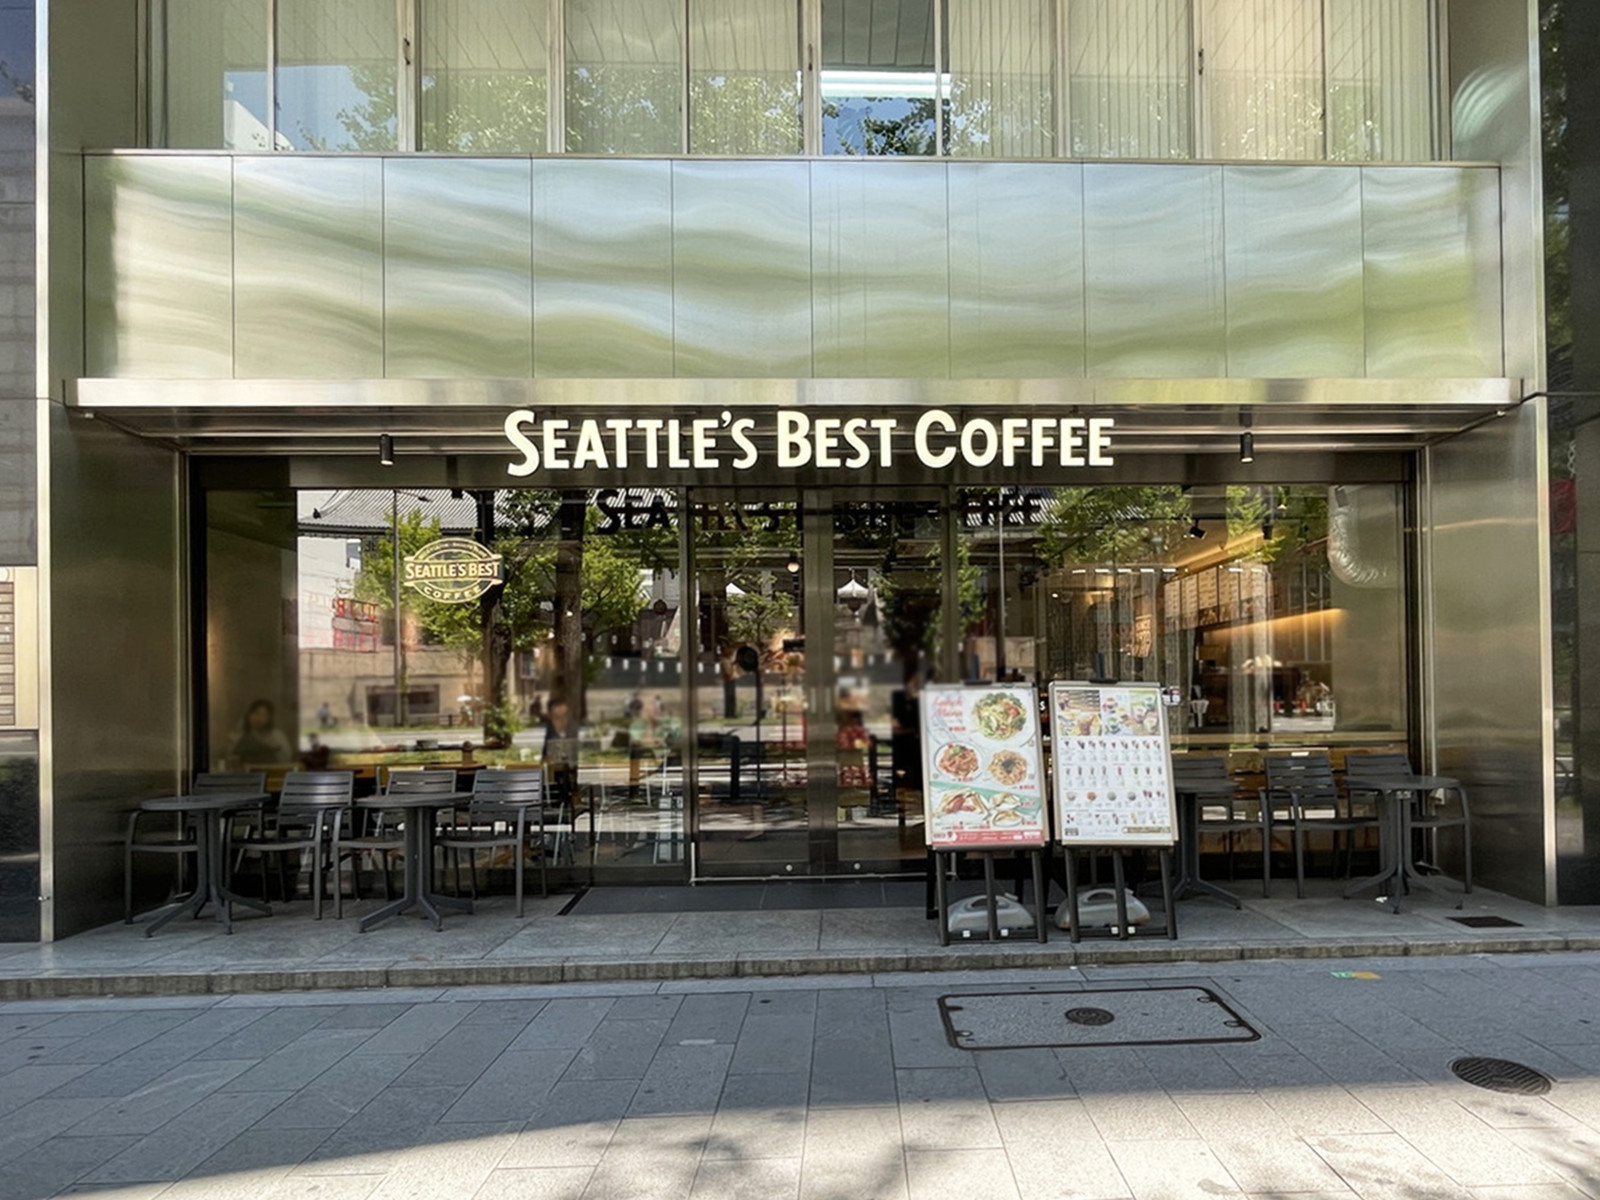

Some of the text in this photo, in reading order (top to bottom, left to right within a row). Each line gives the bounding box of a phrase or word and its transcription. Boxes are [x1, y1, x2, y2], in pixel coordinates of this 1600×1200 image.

[504, 409, 1115, 477] SEATTLE'S BEST COFFEE
[405, 561, 500, 579] SEATTLE'S BEST
[423, 585, 481, 600] COFFEE
